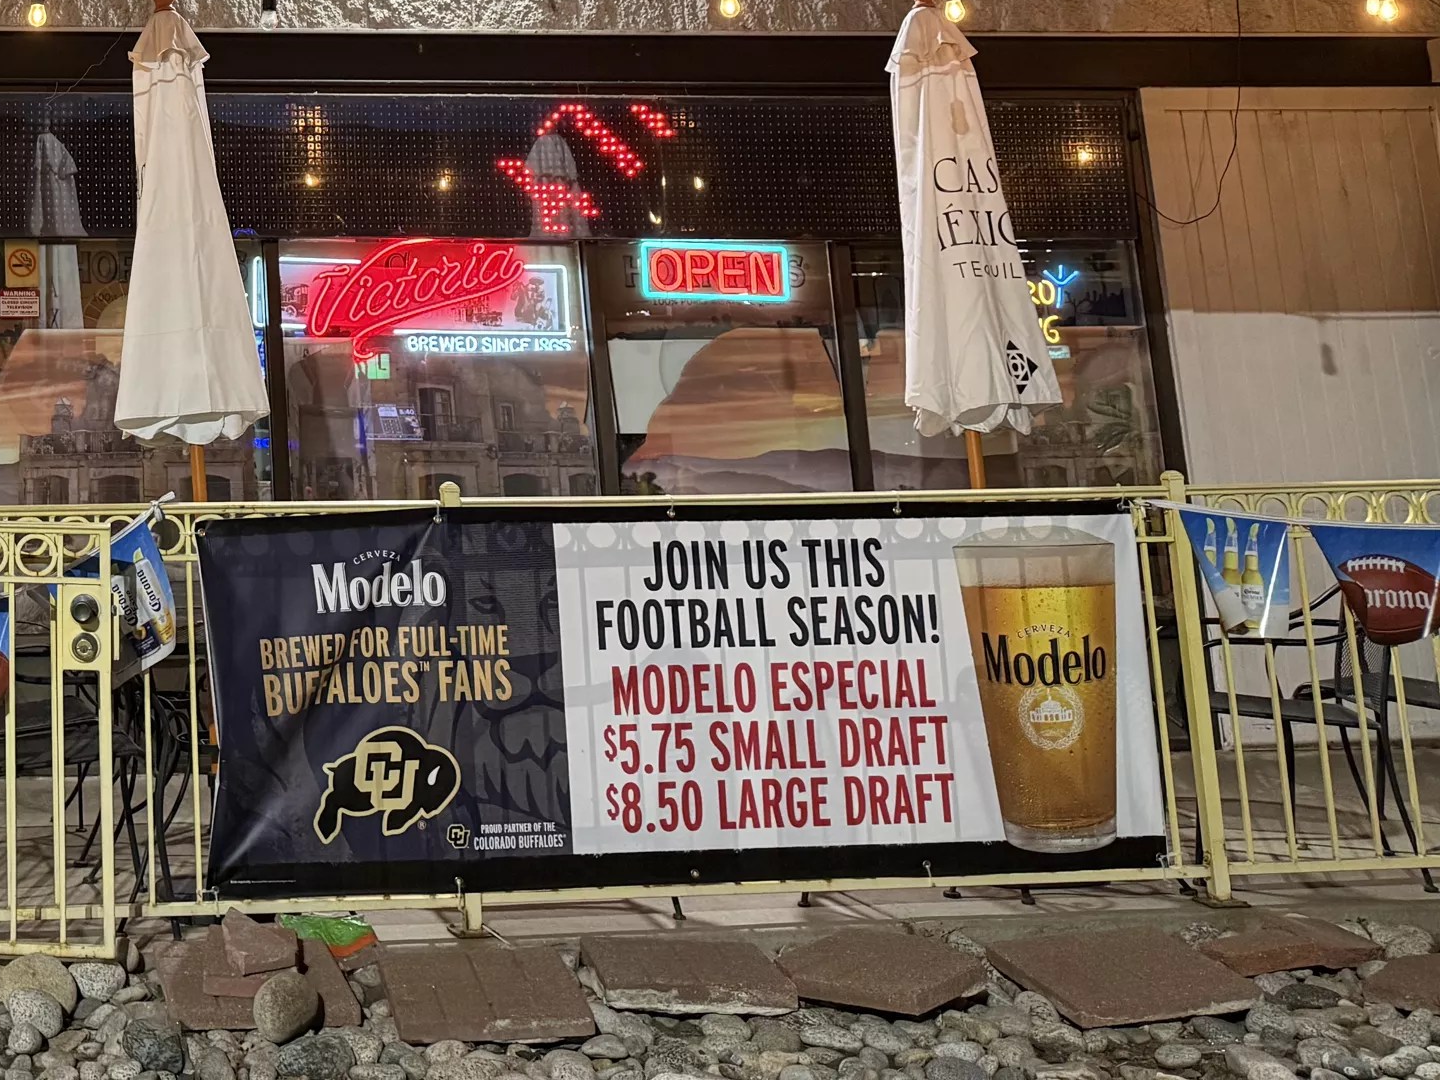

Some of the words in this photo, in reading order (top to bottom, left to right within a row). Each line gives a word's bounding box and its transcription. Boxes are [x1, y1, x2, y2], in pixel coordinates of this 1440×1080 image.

[311, 239, 524, 337] Victoria
[649, 248, 780, 295] OPEN
[408, 336, 479, 352] BREWED
[353, 549, 401, 565] CERVEZA
[643, 539, 738, 591] JOIN
[742, 538, 791, 591] US
[800, 536, 885, 588] THIS
[137, 569, 161, 612] Corona
[311, 559, 447, 614] Modelo
[1363, 587, 1433, 610] orona
[596, 596, 776, 651] FOOTBALL
[788, 593, 941, 647] SEASON!
[1016, 624, 1072, 640] CERVEZA
[260, 632, 346, 670] BREWED
[348, 626, 390, 659] FOR
[398, 624, 510, 657] FULL-TIME
[980, 631, 1107, 688] Modelo
[439, 659, 513, 702] FANS
[611, 661, 757, 717] MODELO
[771, 658, 937, 713] ESPECIAL
[603, 721, 696, 776] $5.75
[710, 717, 827, 773] SMALL
[839, 715, 949, 769] DRAFT
[606, 780, 706, 834] $8.50
[718, 777, 832, 830] LARGE
[843, 772, 956, 826] DRAFT
[473, 836, 517, 851] COLORADO
[480, 824, 503, 834] PROUD
[503, 822, 532, 833] PARTNER
[533, 822, 542, 832] OF
[543, 821, 556, 832] THE
